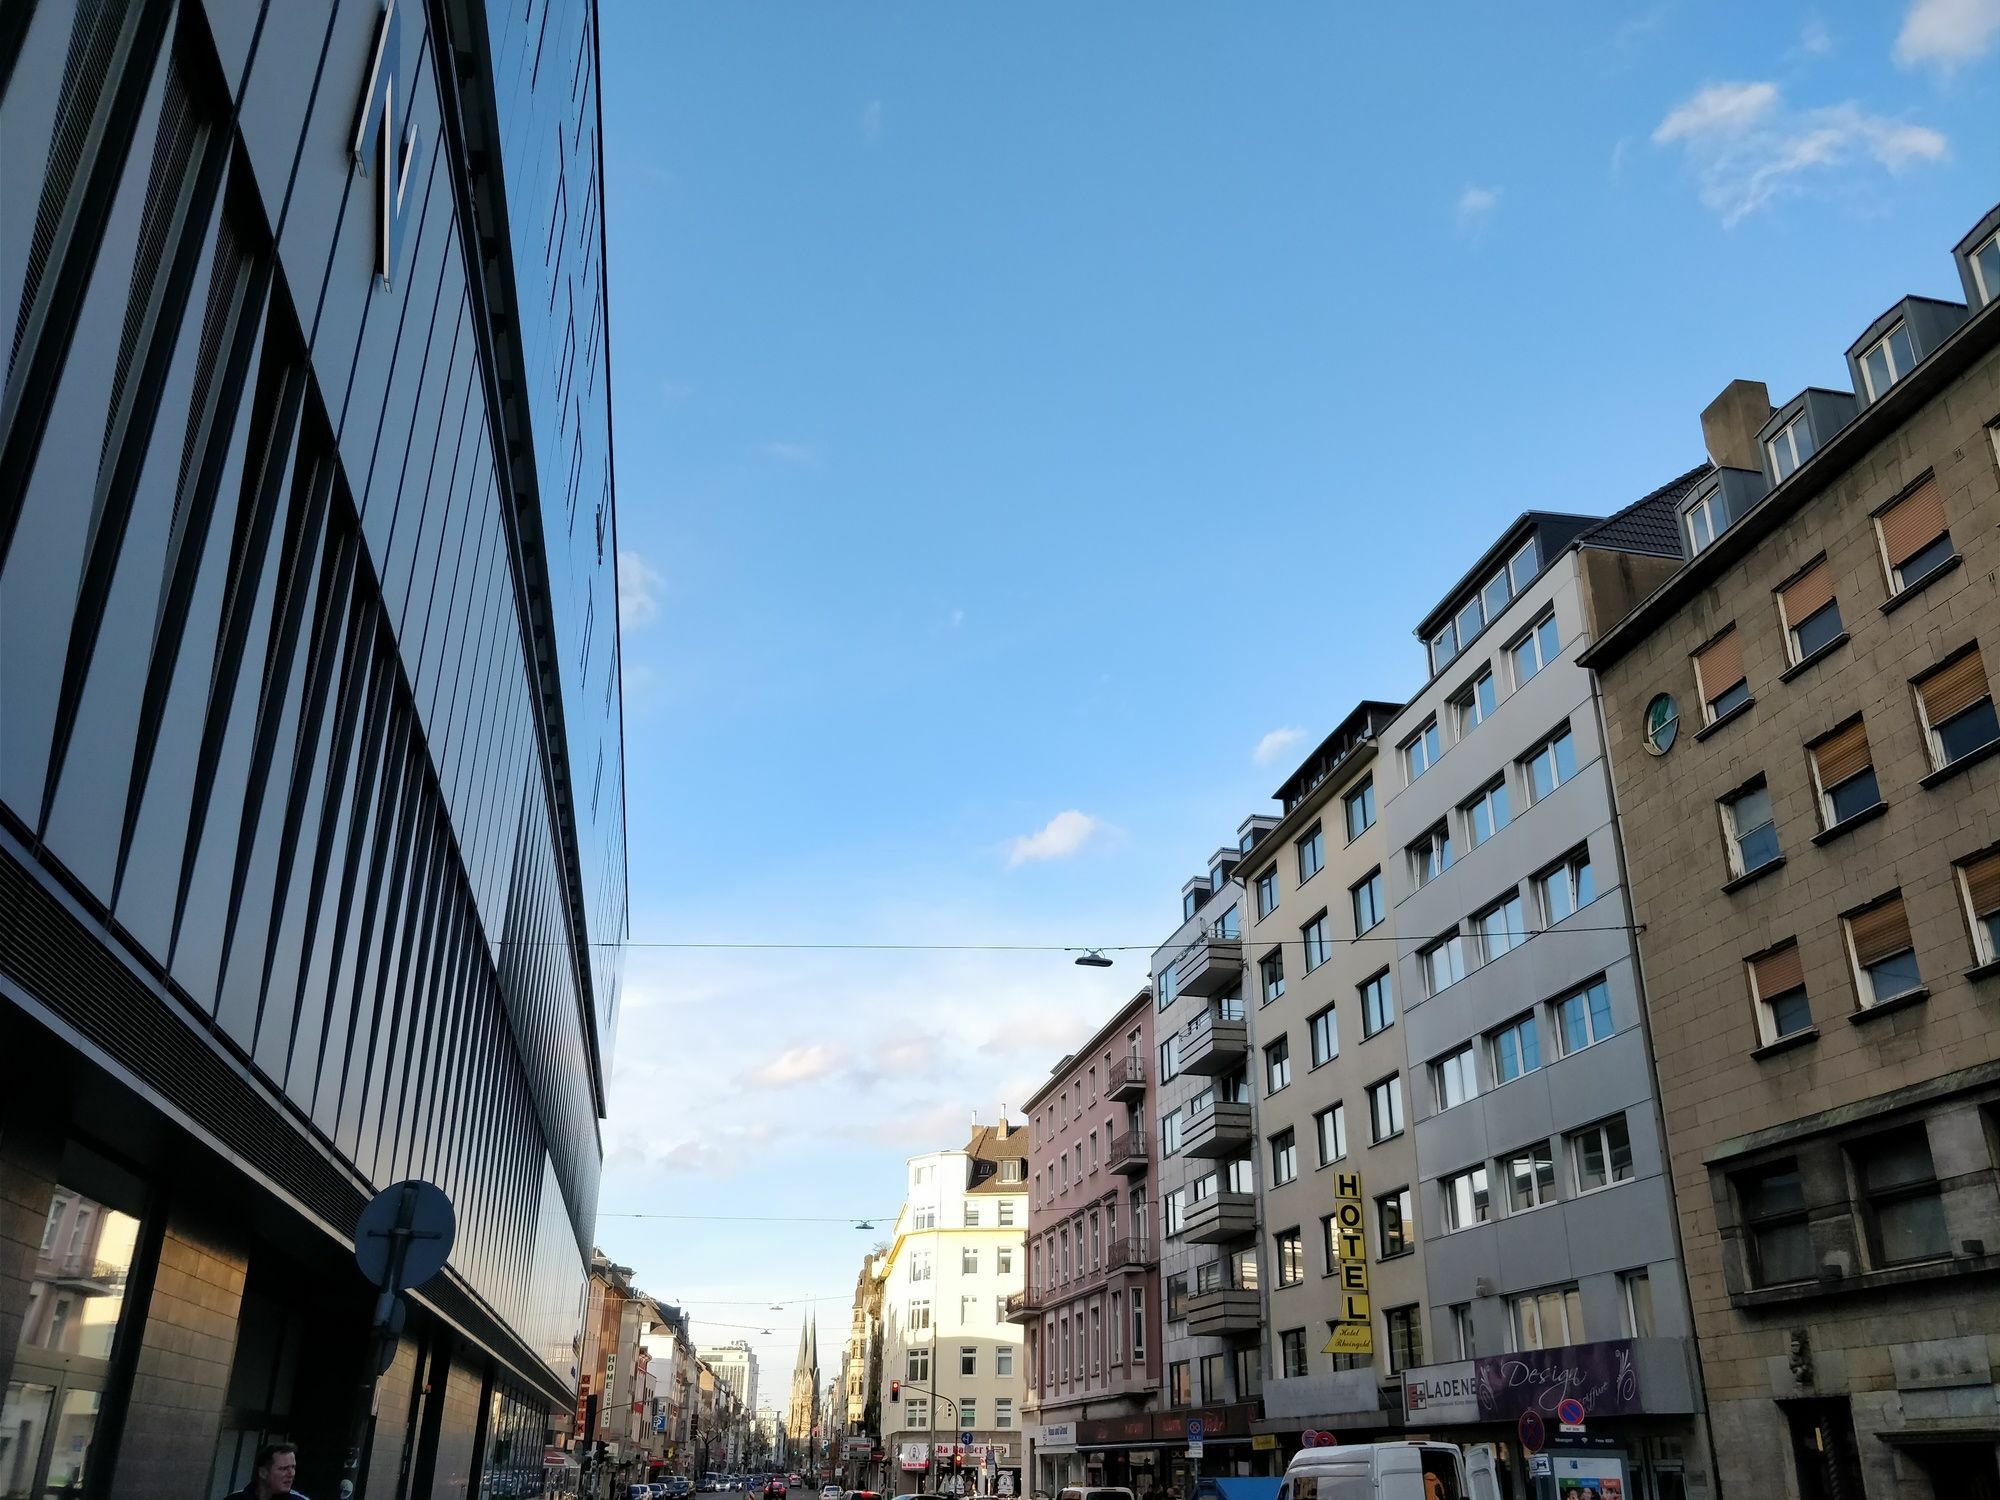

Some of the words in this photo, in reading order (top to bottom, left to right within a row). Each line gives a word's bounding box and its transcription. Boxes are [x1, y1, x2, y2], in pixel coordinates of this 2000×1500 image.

[1338, 1174, 1367, 1320] HOTEL
[1335, 1339, 1371, 1349] Rheingold
[1339, 1328, 1360, 1337] Hotel
[606, 1356, 615, 1389] HOME
[1500, 1360, 1587, 1411] Design
[578, 1376, 591, 1430] OPTIK
